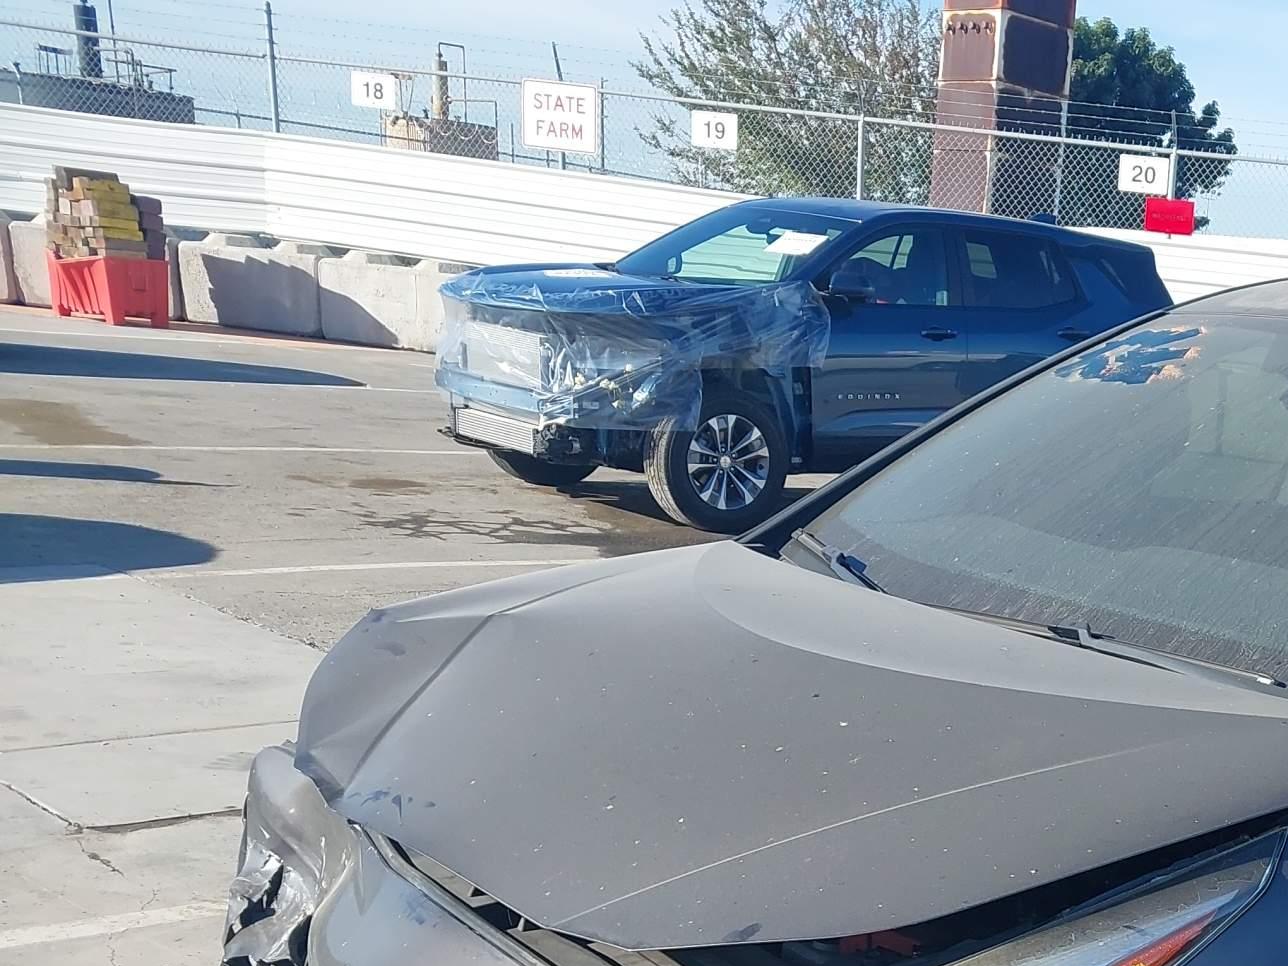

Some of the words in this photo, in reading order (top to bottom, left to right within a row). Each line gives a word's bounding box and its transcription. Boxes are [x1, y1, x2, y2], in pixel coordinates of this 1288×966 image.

[362, 81, 384, 100] 18
[533, 93, 586, 115] STATE
[536, 119, 583, 140] FARM
[703, 121, 726, 140] 19
[1131, 165, 1156, 184] 20
